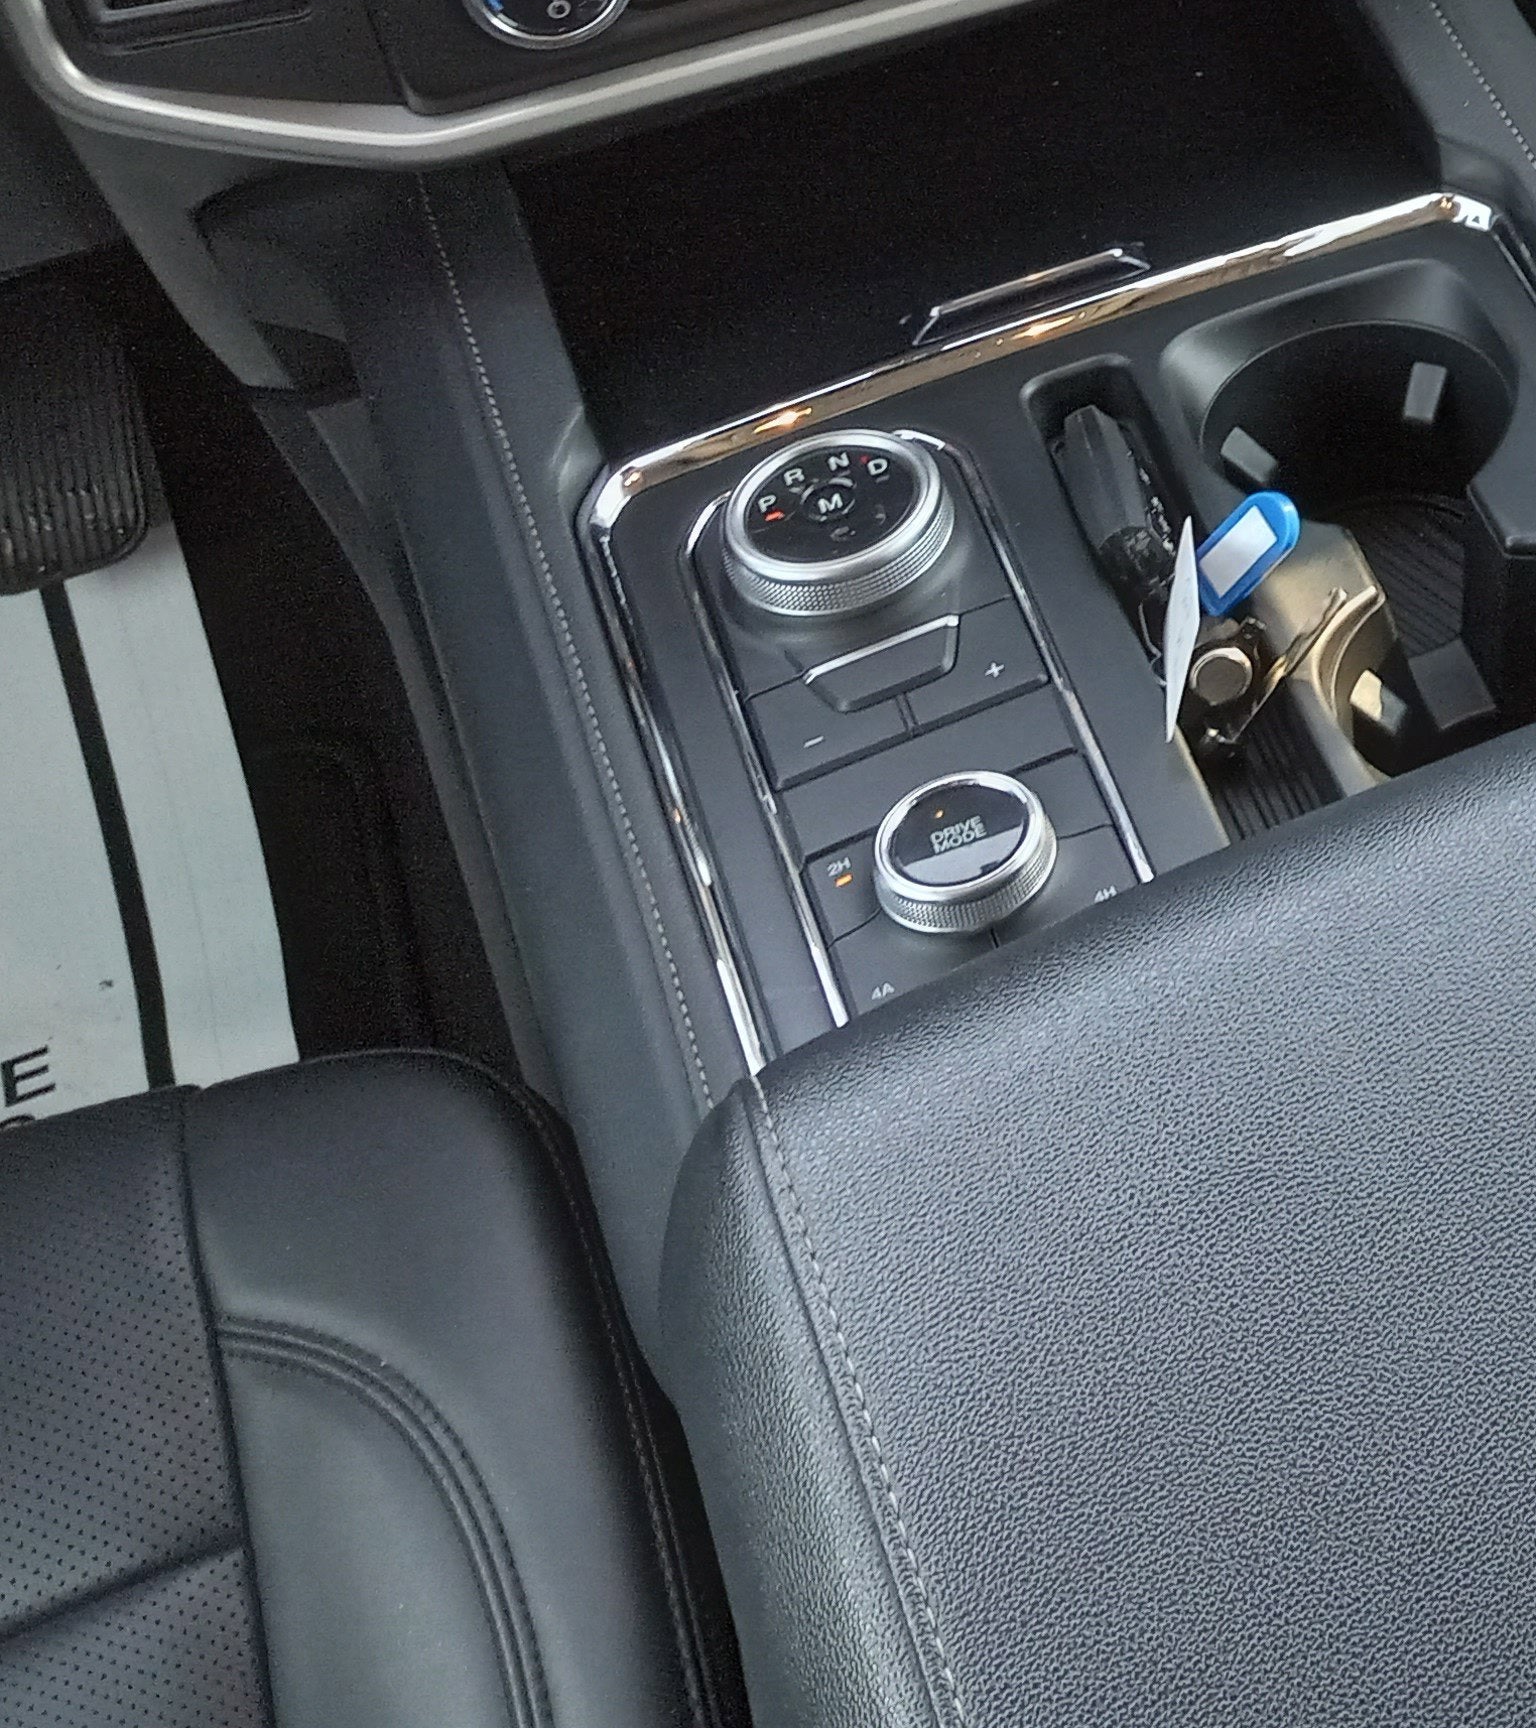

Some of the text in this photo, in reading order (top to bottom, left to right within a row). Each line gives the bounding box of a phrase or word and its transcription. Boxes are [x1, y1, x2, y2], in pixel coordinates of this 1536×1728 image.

[758, 452, 888, 513] P R N D
[817, 492, 843, 514] M
[930, 815, 982, 844] DRIVE
[934, 822, 987, 854] MODE
[827, 857, 852, 876] 2H
[1094, 885, 1117, 903] 4H
[871, 982, 895, 1000] 4A
